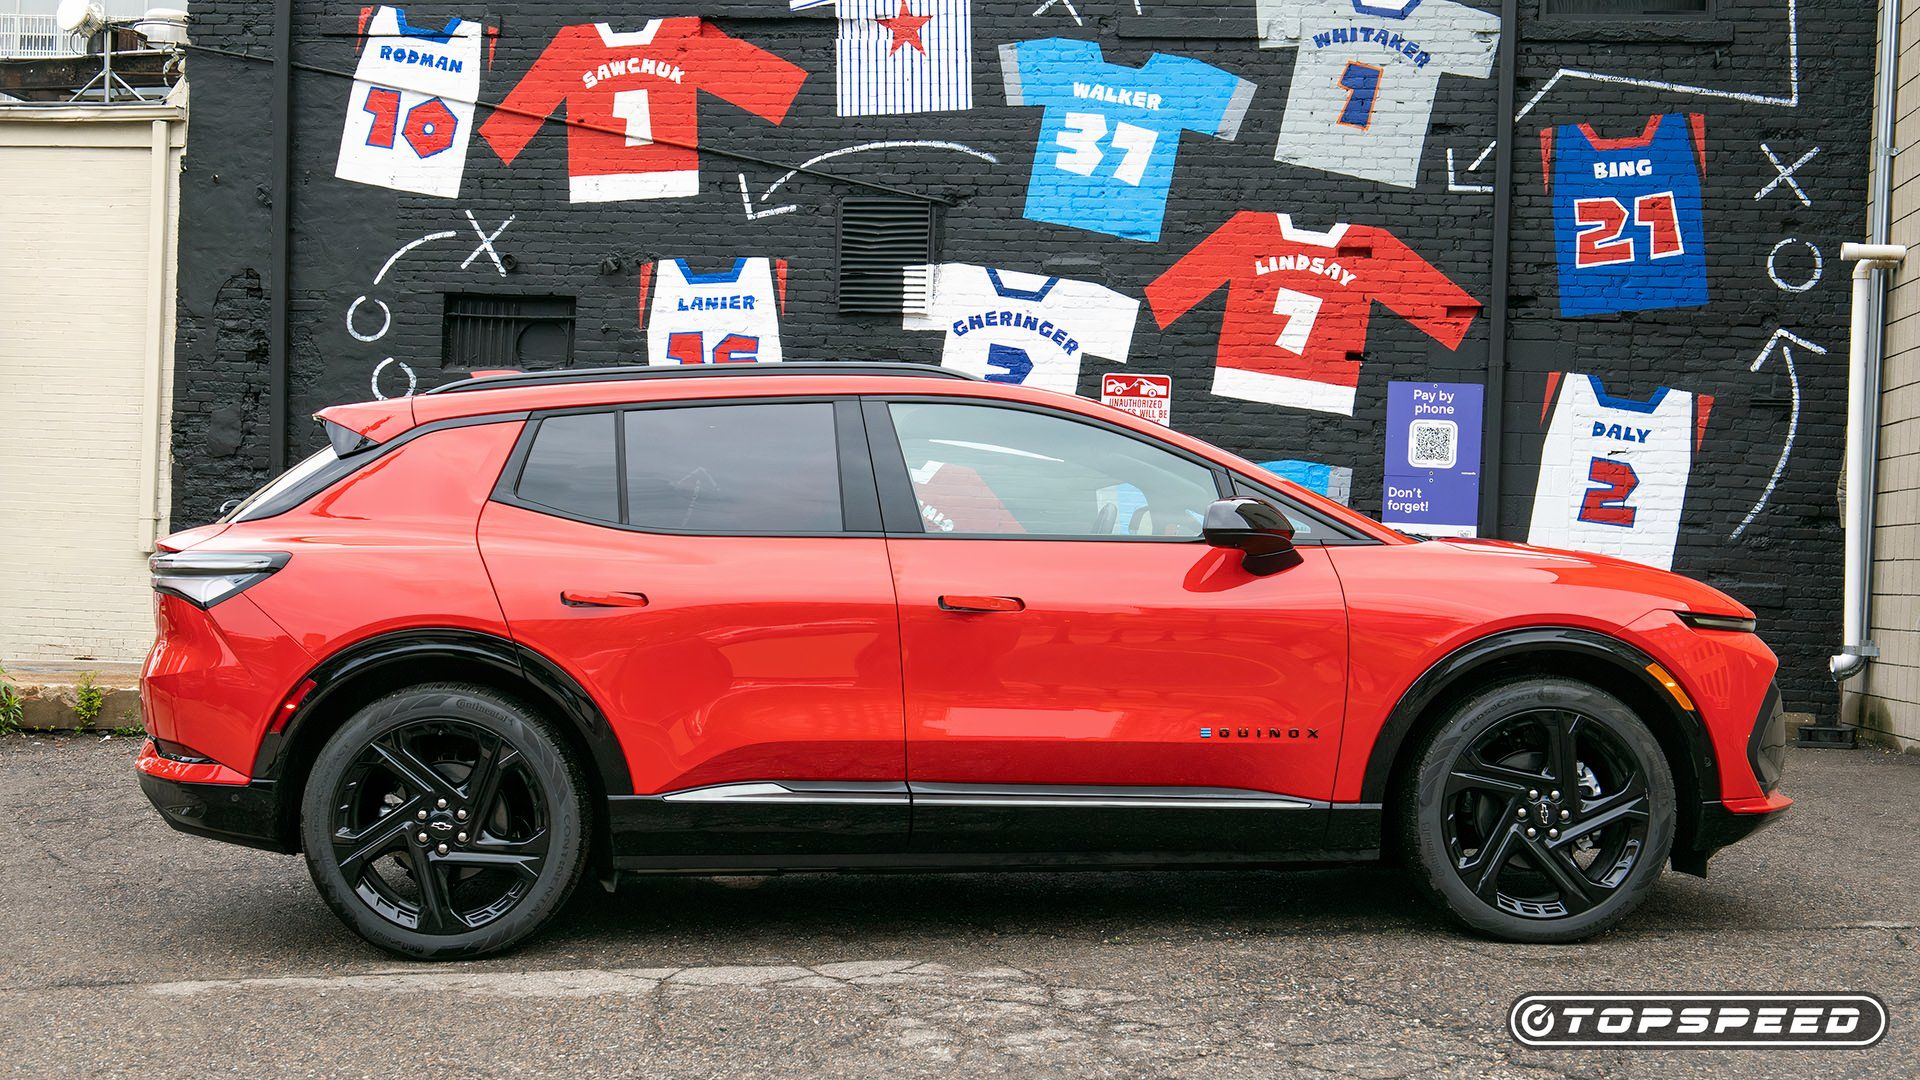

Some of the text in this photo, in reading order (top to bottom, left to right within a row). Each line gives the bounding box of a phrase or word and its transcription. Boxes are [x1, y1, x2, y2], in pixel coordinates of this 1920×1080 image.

[380, 45, 463, 74] RODMAN
[1313, 27, 1431, 69] WHITAKER
[582, 57, 685, 89] SAWCHUK
[1073, 81, 1162, 111] WALKER
[1337, 60, 1384, 131] 1
[362, 86, 458, 159] 10
[612, 89, 653, 147] 1
[1055, 111, 1159, 187] 37
[1593, 159, 1653, 179] BING
[1573, 190, 1685, 269] 21
[1255, 254, 1357, 287] LINDSAY
[677, 295, 756, 312] LANIER
[953, 310, 1079, 356] GHERINGER
[1273, 287, 1323, 355] 7
[1108, 398, 1163, 409] UNAUTHORIZED
[1413, 389, 1455, 403] Pay by
[1415, 403, 1455, 415] phone
[1140, 410, 1156, 418] WILL
[1158, 410, 1168, 419] BE
[1592, 421, 1651, 444] DALY
[1387, 500, 1429, 513] forget!
[1577, 456, 1640, 529] 2
[1200, 727, 1319, 738] EQUINOX
